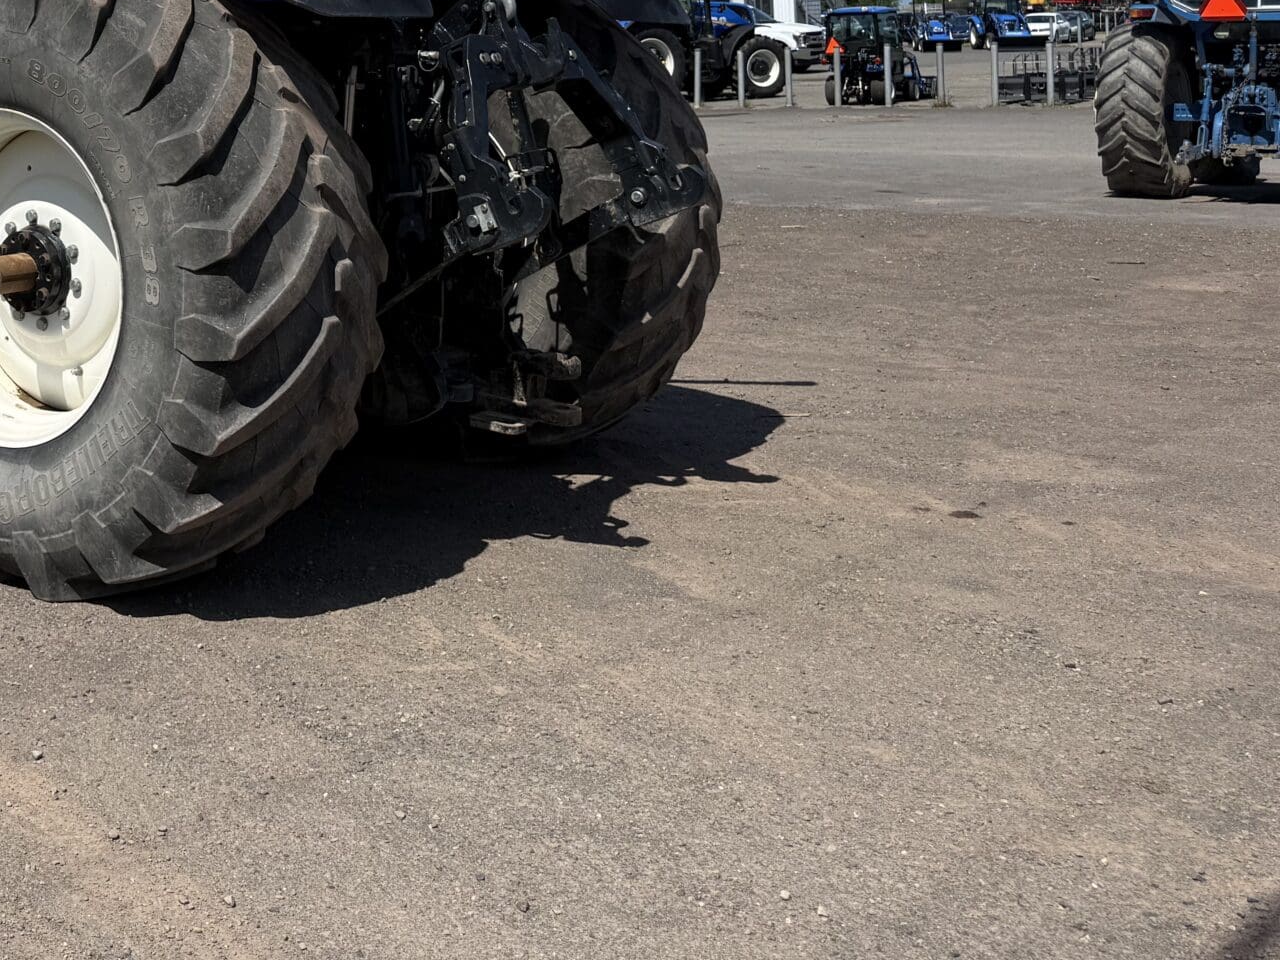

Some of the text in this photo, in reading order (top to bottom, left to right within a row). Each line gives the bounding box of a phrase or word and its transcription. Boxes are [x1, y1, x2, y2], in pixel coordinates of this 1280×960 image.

[27, 59, 132, 183] 800/70
[128, 195, 150, 228] R
[140, 243, 161, 307] 38
